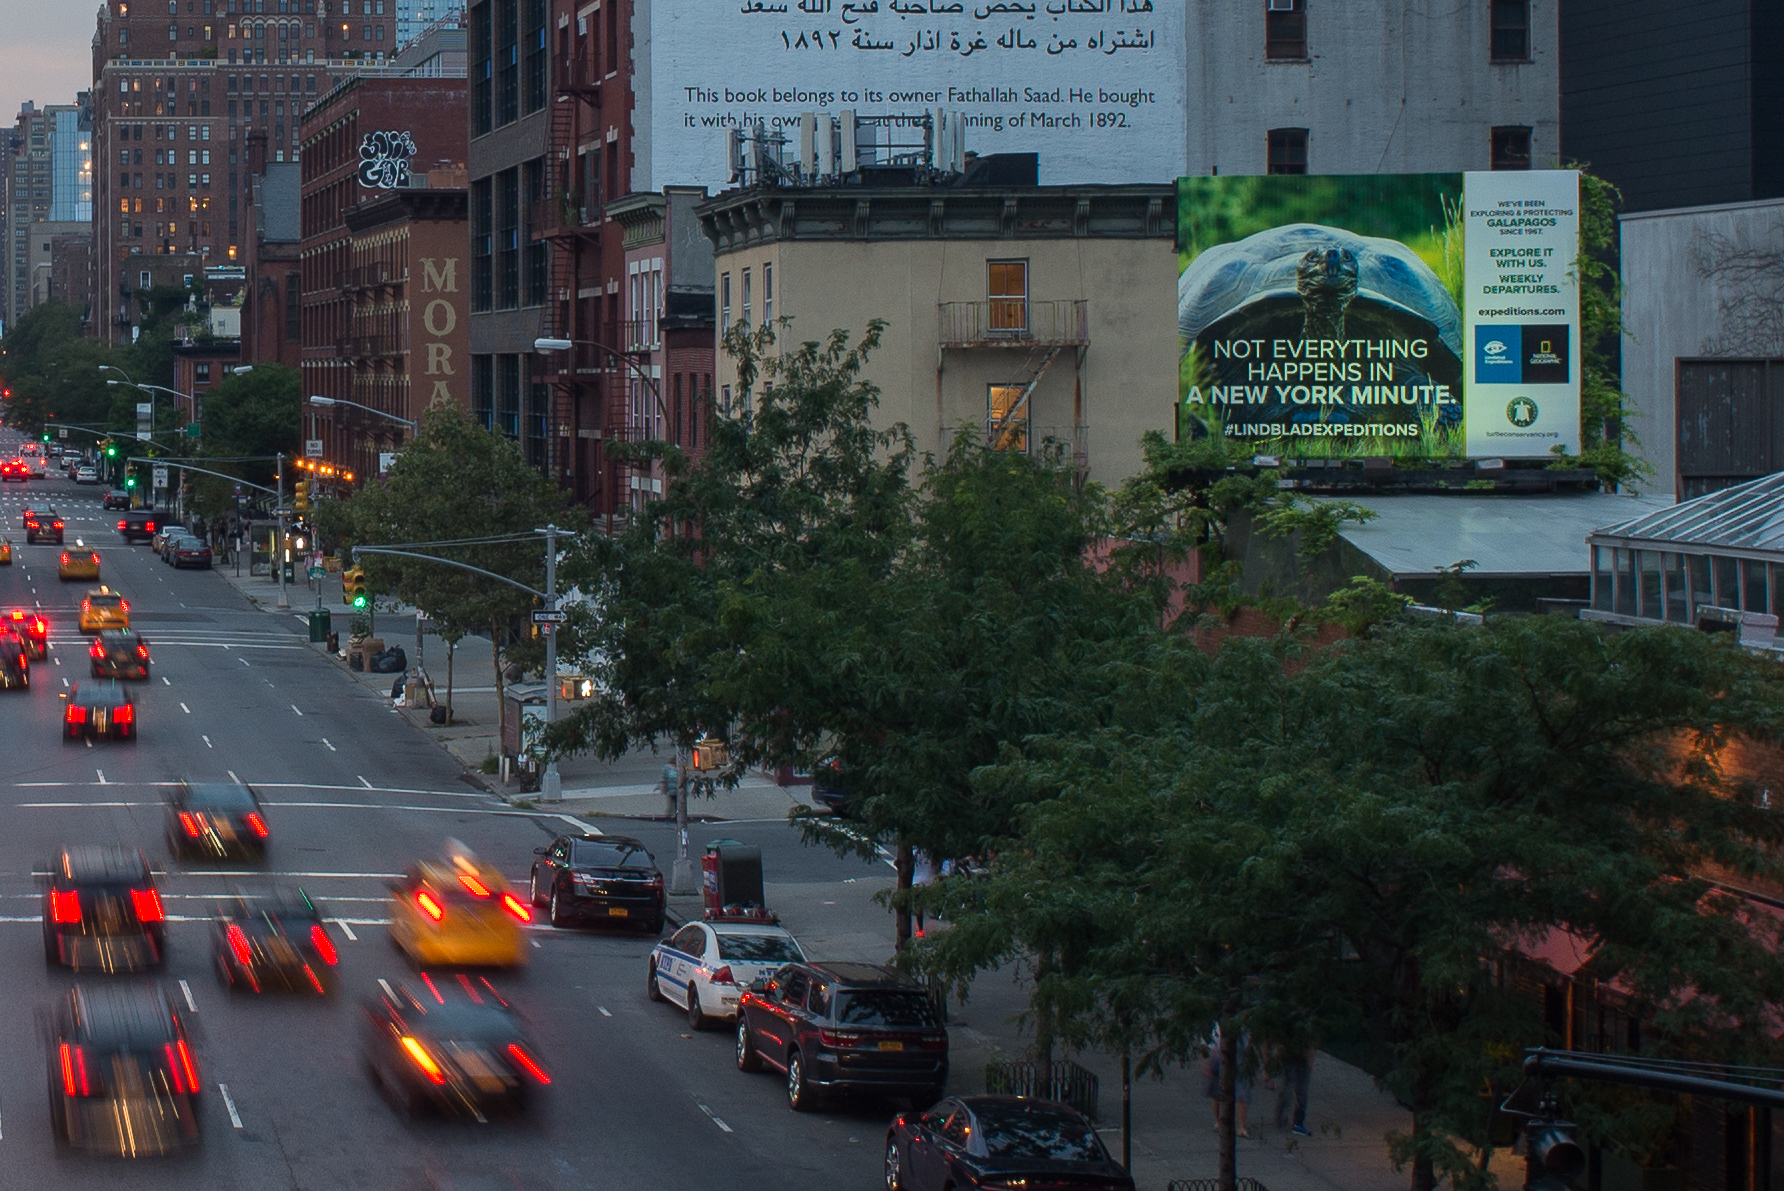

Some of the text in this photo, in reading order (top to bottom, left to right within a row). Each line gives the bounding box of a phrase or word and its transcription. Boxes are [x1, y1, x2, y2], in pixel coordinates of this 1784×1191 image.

[740, 0, 788, 14] سعد
[781, 28, 1154, 57] اشتراه من ماله غرة اذار سنة ١٨٩٢
[684, 87, 1155, 107] This book belongs to its owner Fathallah Saad. He bought
[684, 113, 696, 128] it
[700, 112, 737, 128] with
[743, 112, 765, 127] his
[1008, 112, 1027, 128] of
[1030, 112, 1081, 128] March
[1089, 112, 1131, 128] 1892.
[1524, 200, 1546, 208] BEEN
[1489, 248, 1554, 257] EXPLORE IT
[1496, 259, 1547, 268] WITH US.
[1499, 274, 1544, 283] WEEKLY
[1483, 285, 1561, 294] DEPARTURES.
[1478, 306, 1566, 318] expeditions.com
[1214, 339, 1428, 359] NOT EVERYTHING
[1248, 362, 1394, 382] HAPPENS IN
[1186, 385, 1457, 405] A NEW YORK MINUTE.
[1224, 423, 1418, 437] #LINDBLADEXPEDITIONS
